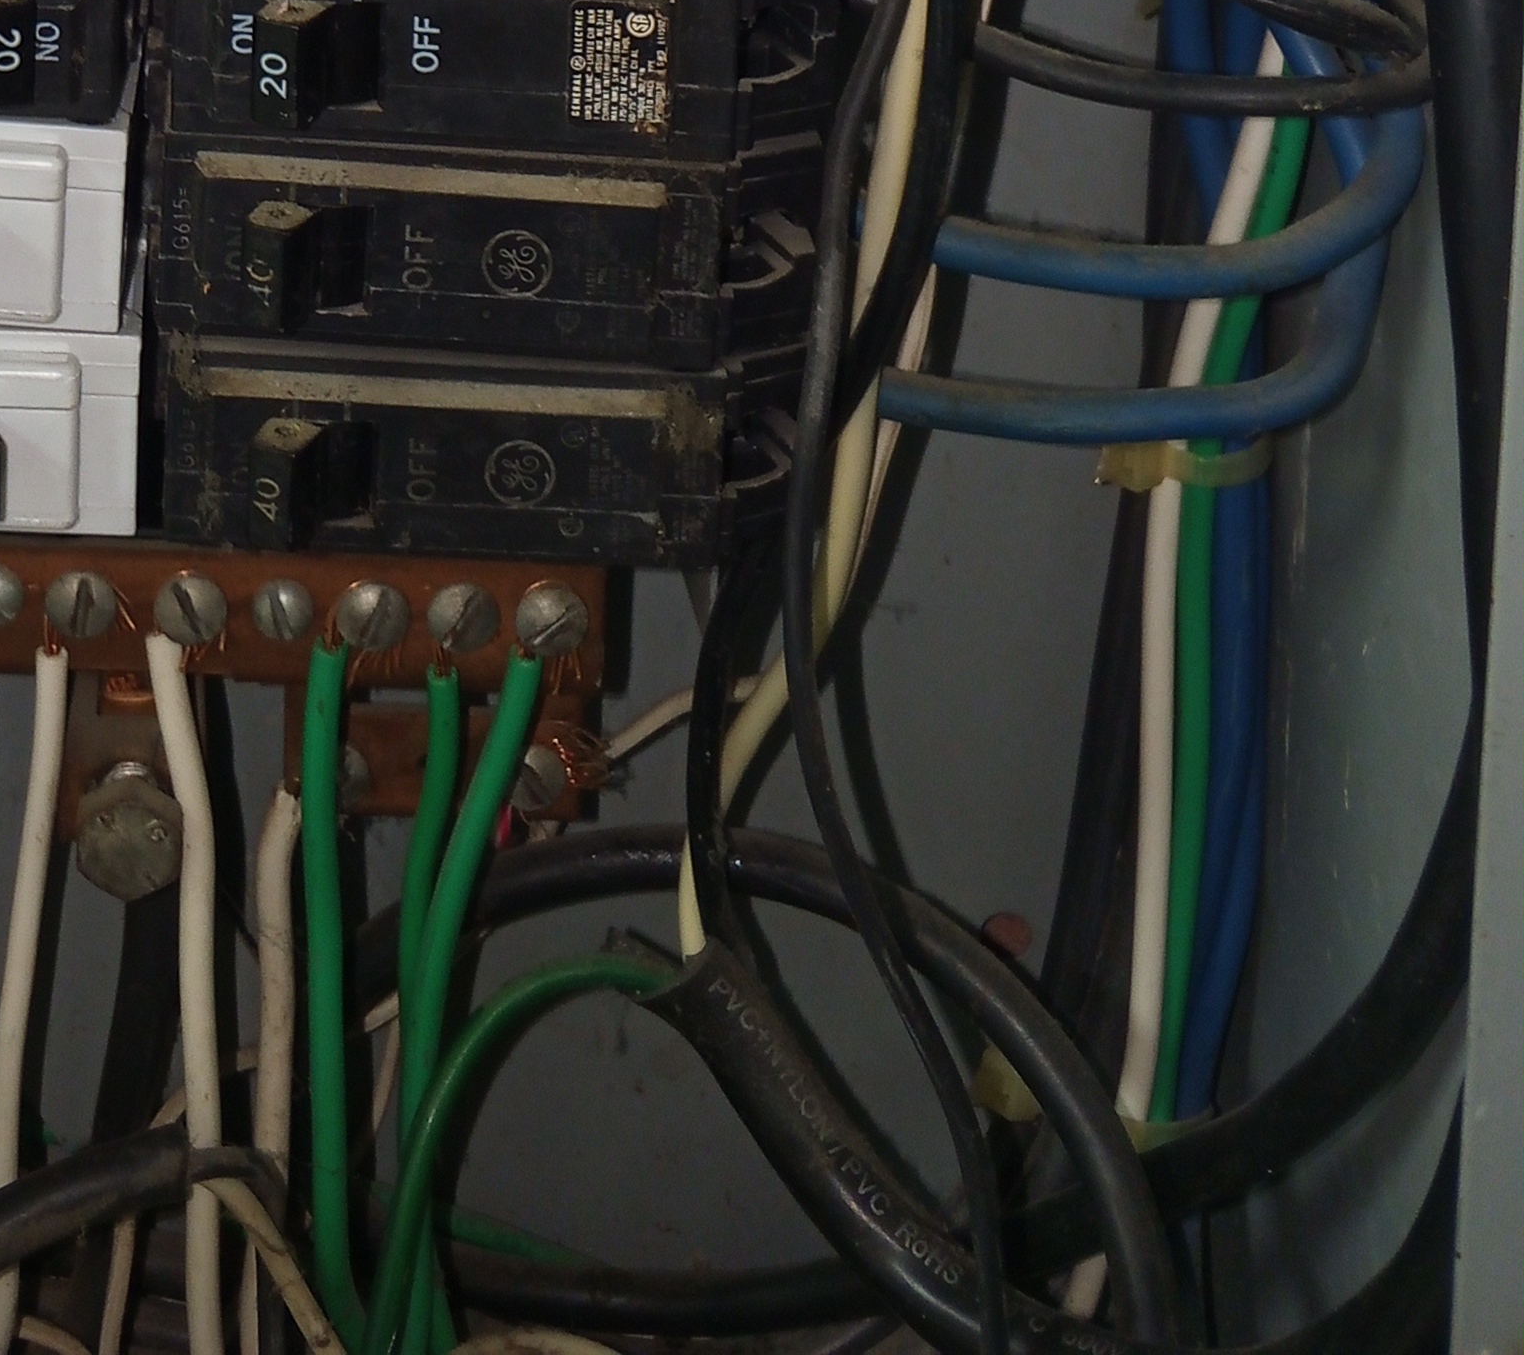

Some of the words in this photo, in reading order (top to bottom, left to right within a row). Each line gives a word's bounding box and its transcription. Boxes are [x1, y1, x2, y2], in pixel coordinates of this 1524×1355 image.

[35, 22, 60, 62] ON
[231, 13, 254, 55] ON
[412, 15, 441, 74] OFF
[259, 53, 288, 99] 20
[403, 224, 436, 291] OFF
[407, 439, 440, 502] OFF
[252, 478, 281, 523] 40
